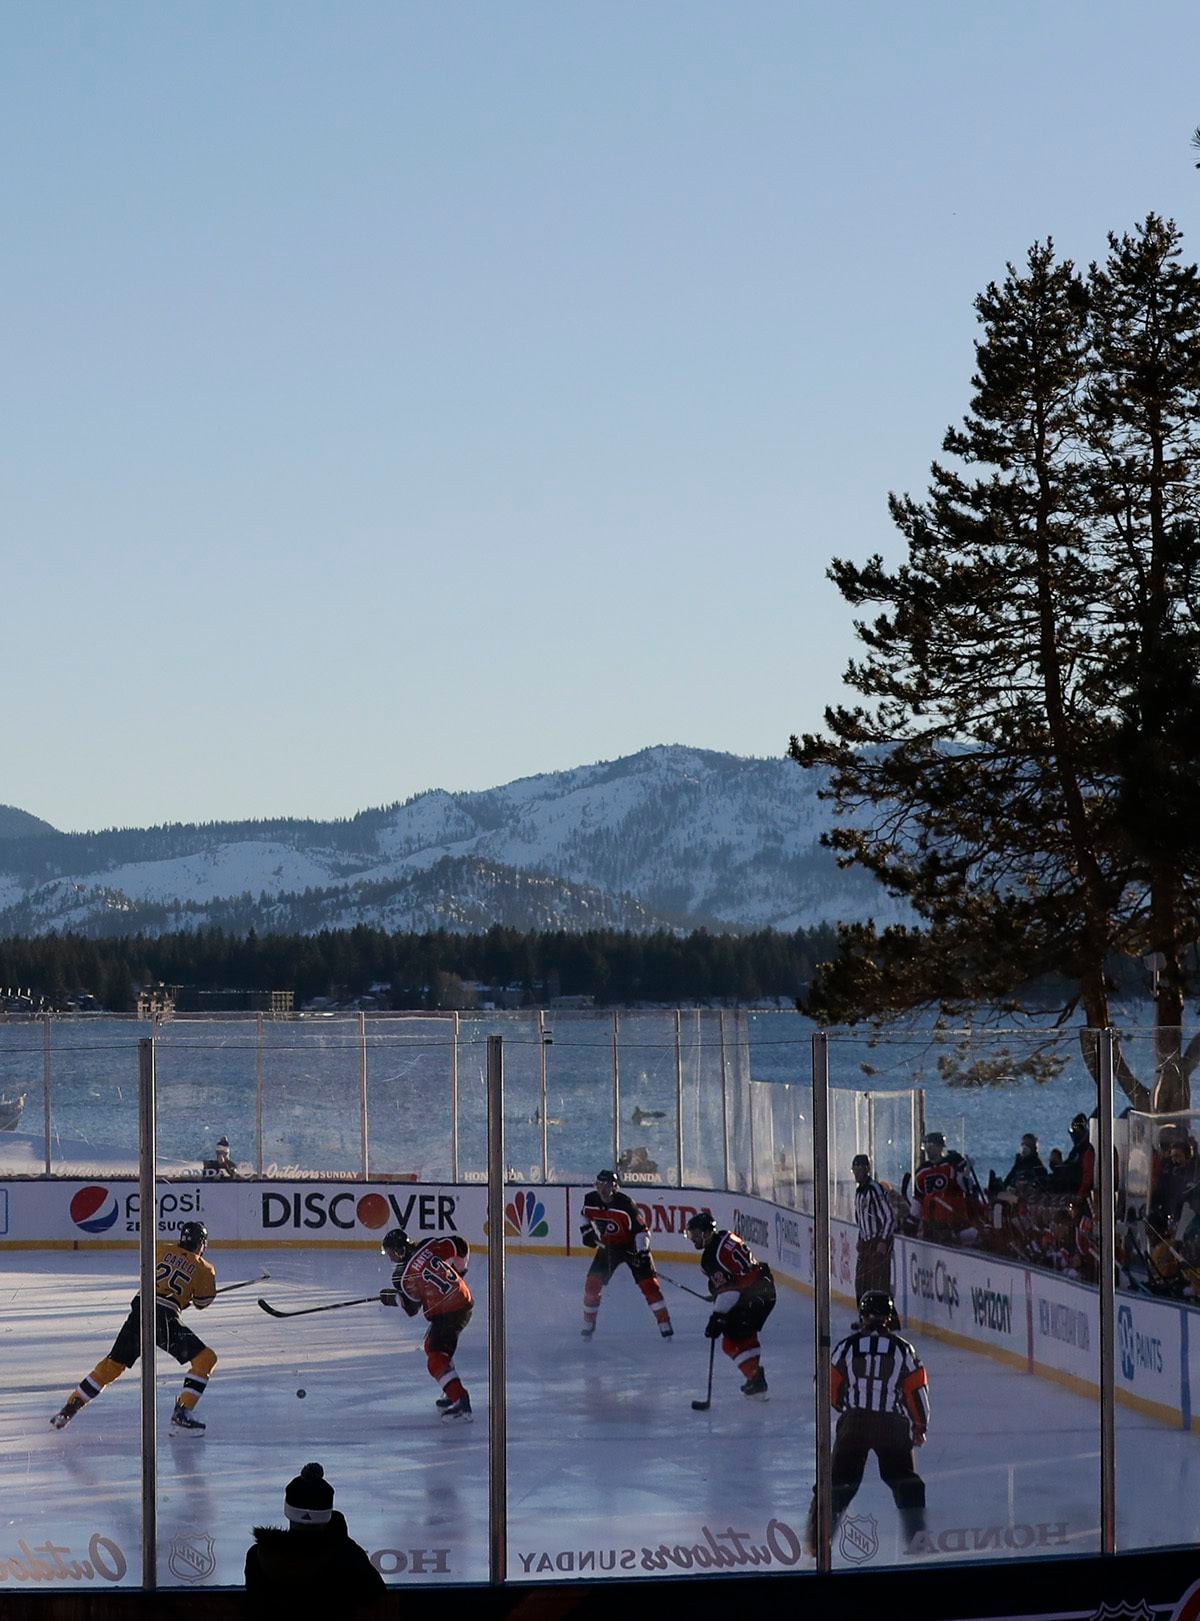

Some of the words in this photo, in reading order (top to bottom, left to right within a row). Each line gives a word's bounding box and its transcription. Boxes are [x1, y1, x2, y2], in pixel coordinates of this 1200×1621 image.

[265, 1162, 320, 1180] Outdoors
[319, 1170, 359, 1180] SUNDAY
[623, 1172, 663, 1182] HONDA
[125, 1188, 201, 1219] ppsi
[262, 1192, 458, 1231] DISCOVER
[163, 1252, 196, 1275] CARLO
[411, 1248, 434, 1272] HAYES
[156, 1261, 192, 1296] 25
[970, 1277, 1012, 1334] verizon
[864, 1354, 882, 1377] 11
[1135, 1331, 1163, 1374] PAINTS
